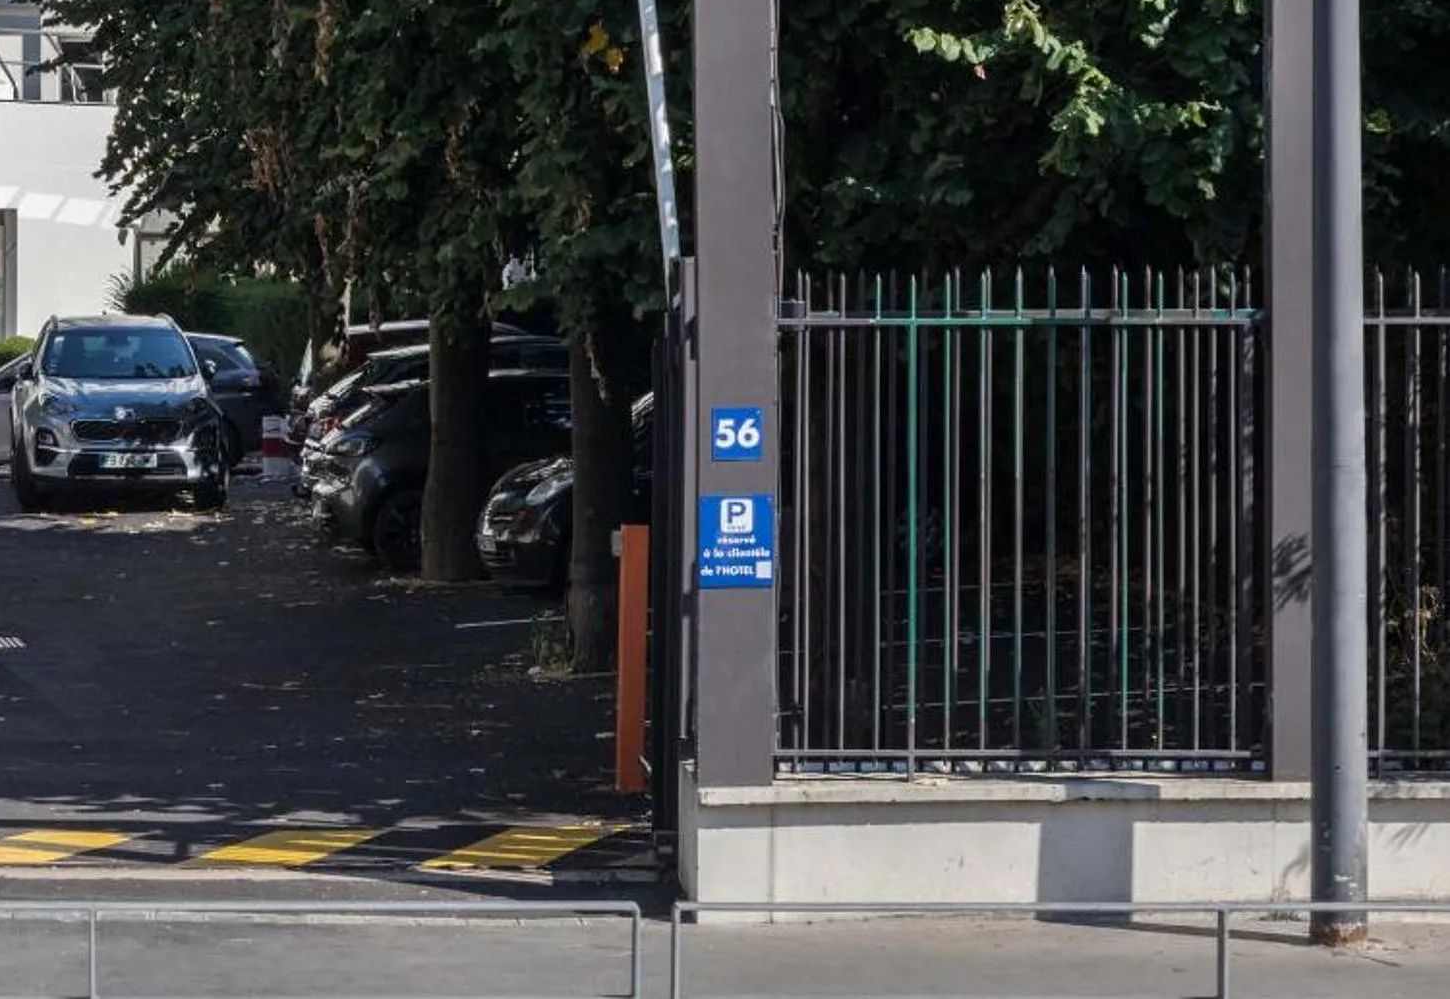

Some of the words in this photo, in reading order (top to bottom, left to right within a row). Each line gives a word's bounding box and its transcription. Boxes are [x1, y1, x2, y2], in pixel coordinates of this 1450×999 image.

[715, 418, 760, 449] 56
[727, 502, 746, 524] P
[700, 565, 714, 576] de
